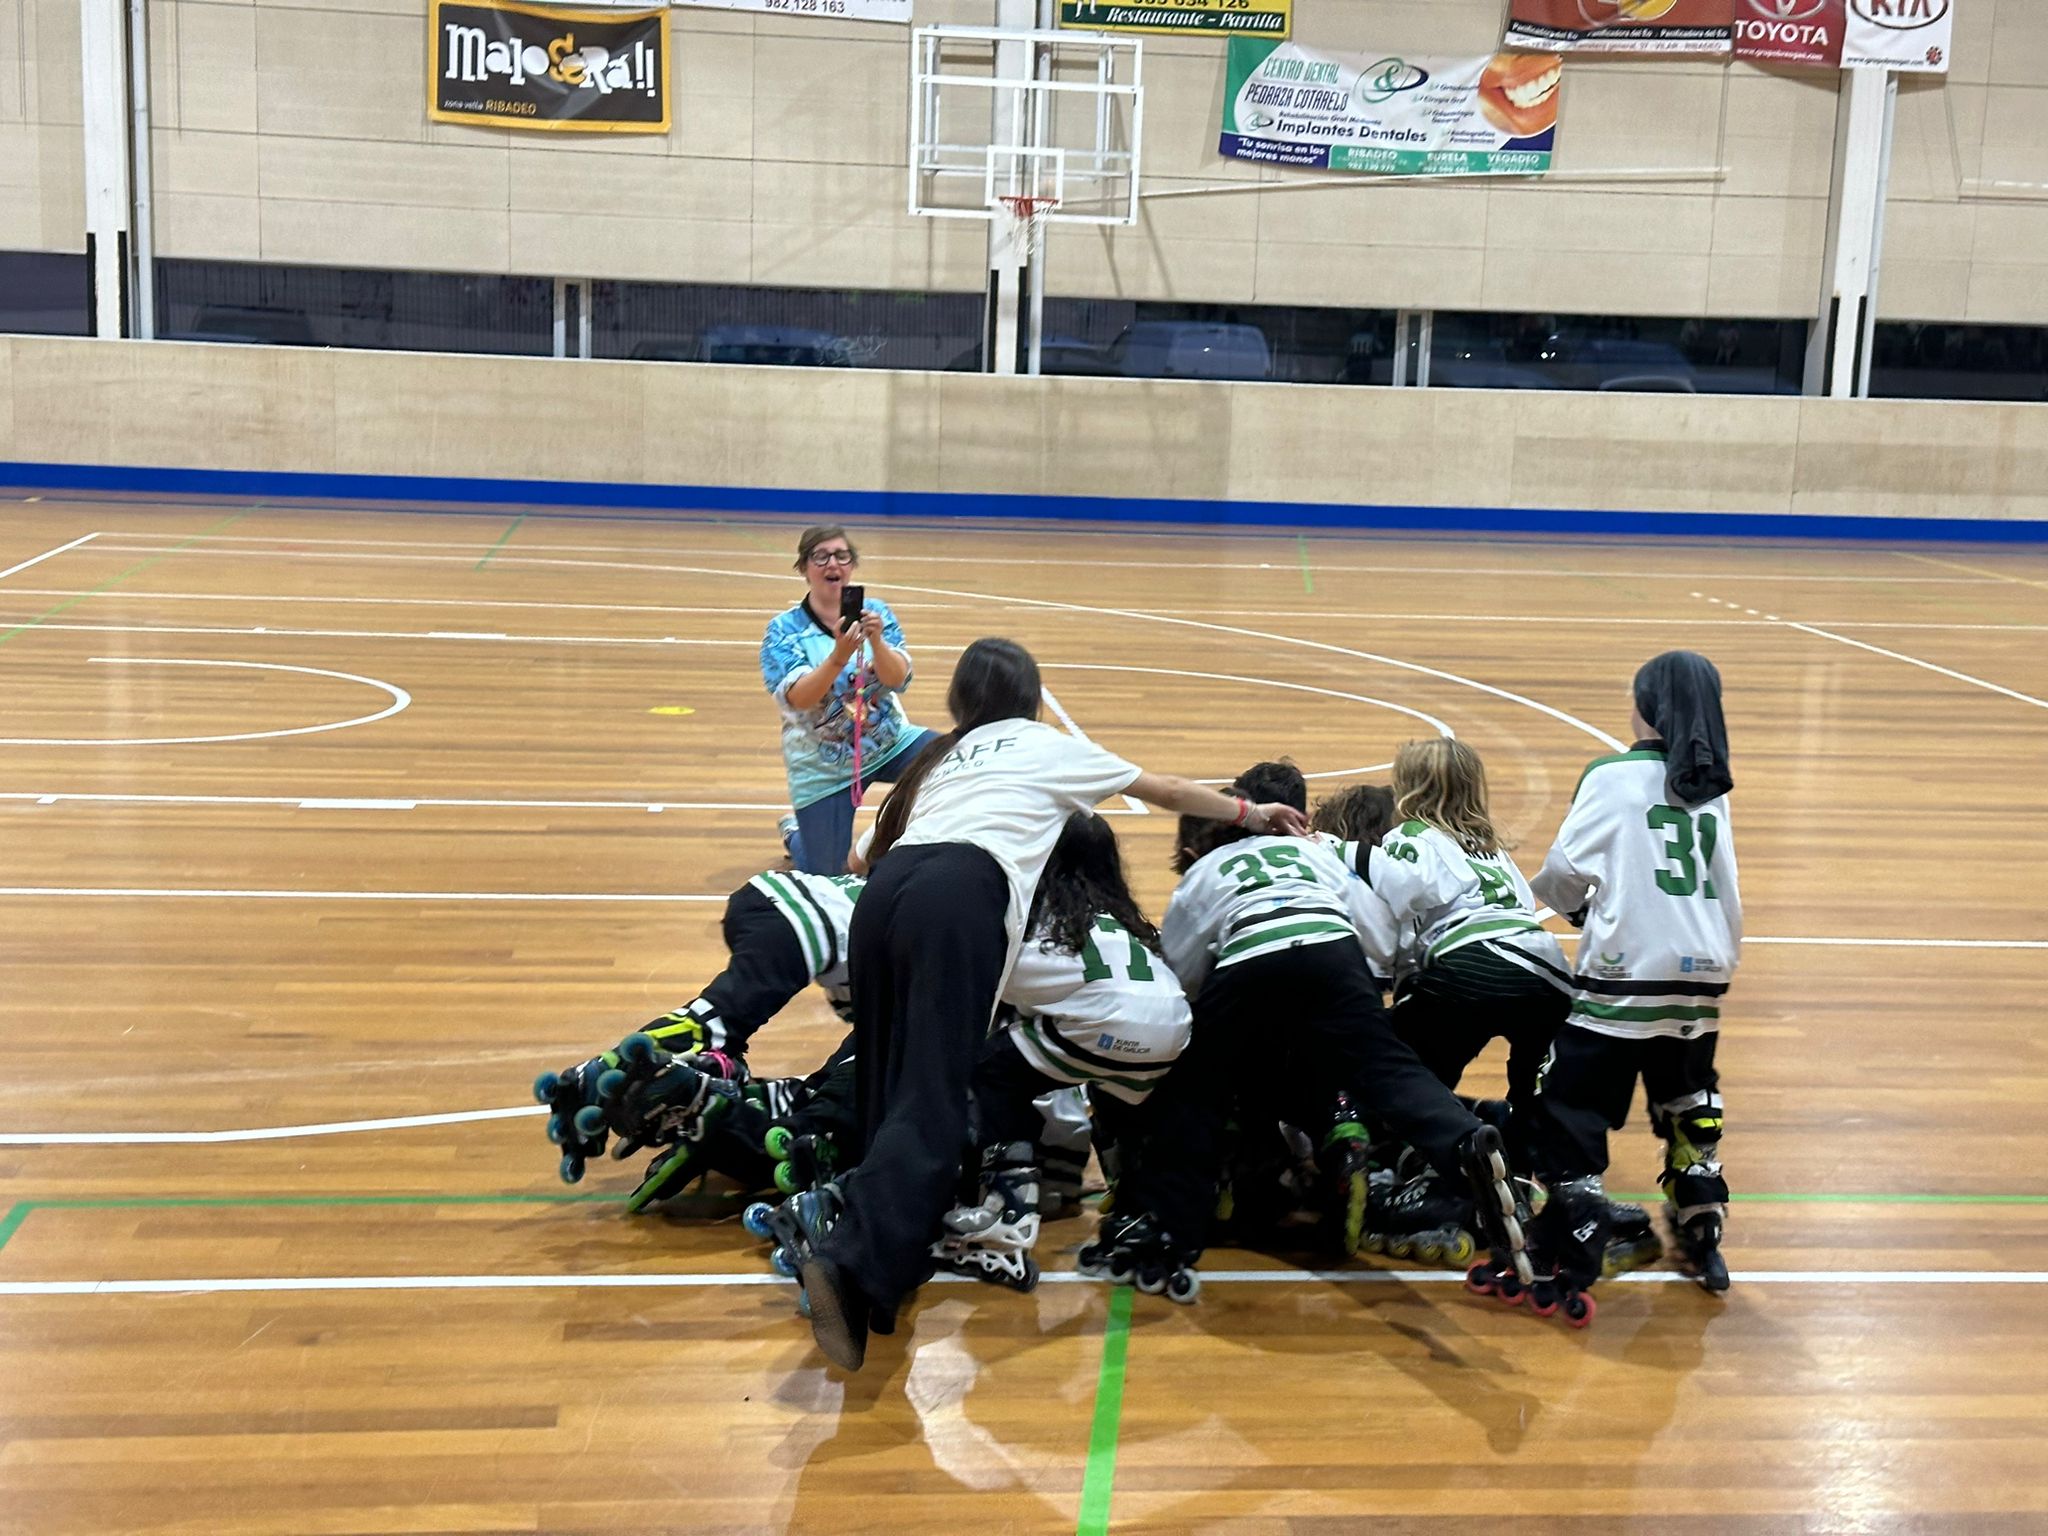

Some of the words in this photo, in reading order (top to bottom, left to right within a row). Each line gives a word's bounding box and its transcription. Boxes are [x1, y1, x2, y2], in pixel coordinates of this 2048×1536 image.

[795, 0, 817, 11] 128
[822, 1, 845, 13] 163
[1106, 7, 1202, 27] Restaurante
[1219, 13, 1283, 30] Parrilla
[1735, 20, 1829, 46] TOYOTA
[1264, 58, 1304, 81] CENTRO
[1304, 61, 1340, 84] DENTAL
[485, 99, 537, 115] RIBADEO
[1245, 82, 1294, 107] PEDRAZA
[1294, 88, 1349, 112] COTARELO
[1277, 120, 1355, 137] Implantes
[1359, 125, 1428, 143] Dentales
[1236, 148, 1278, 160] mejores
[1255, 141, 1293, 153] sonrisa
[1294, 146, 1308, 154] en
[1348, 147, 1399, 160] RIBADEO
[941, 736, 1018, 765] AFF
[1218, 845, 1318, 896] 35
